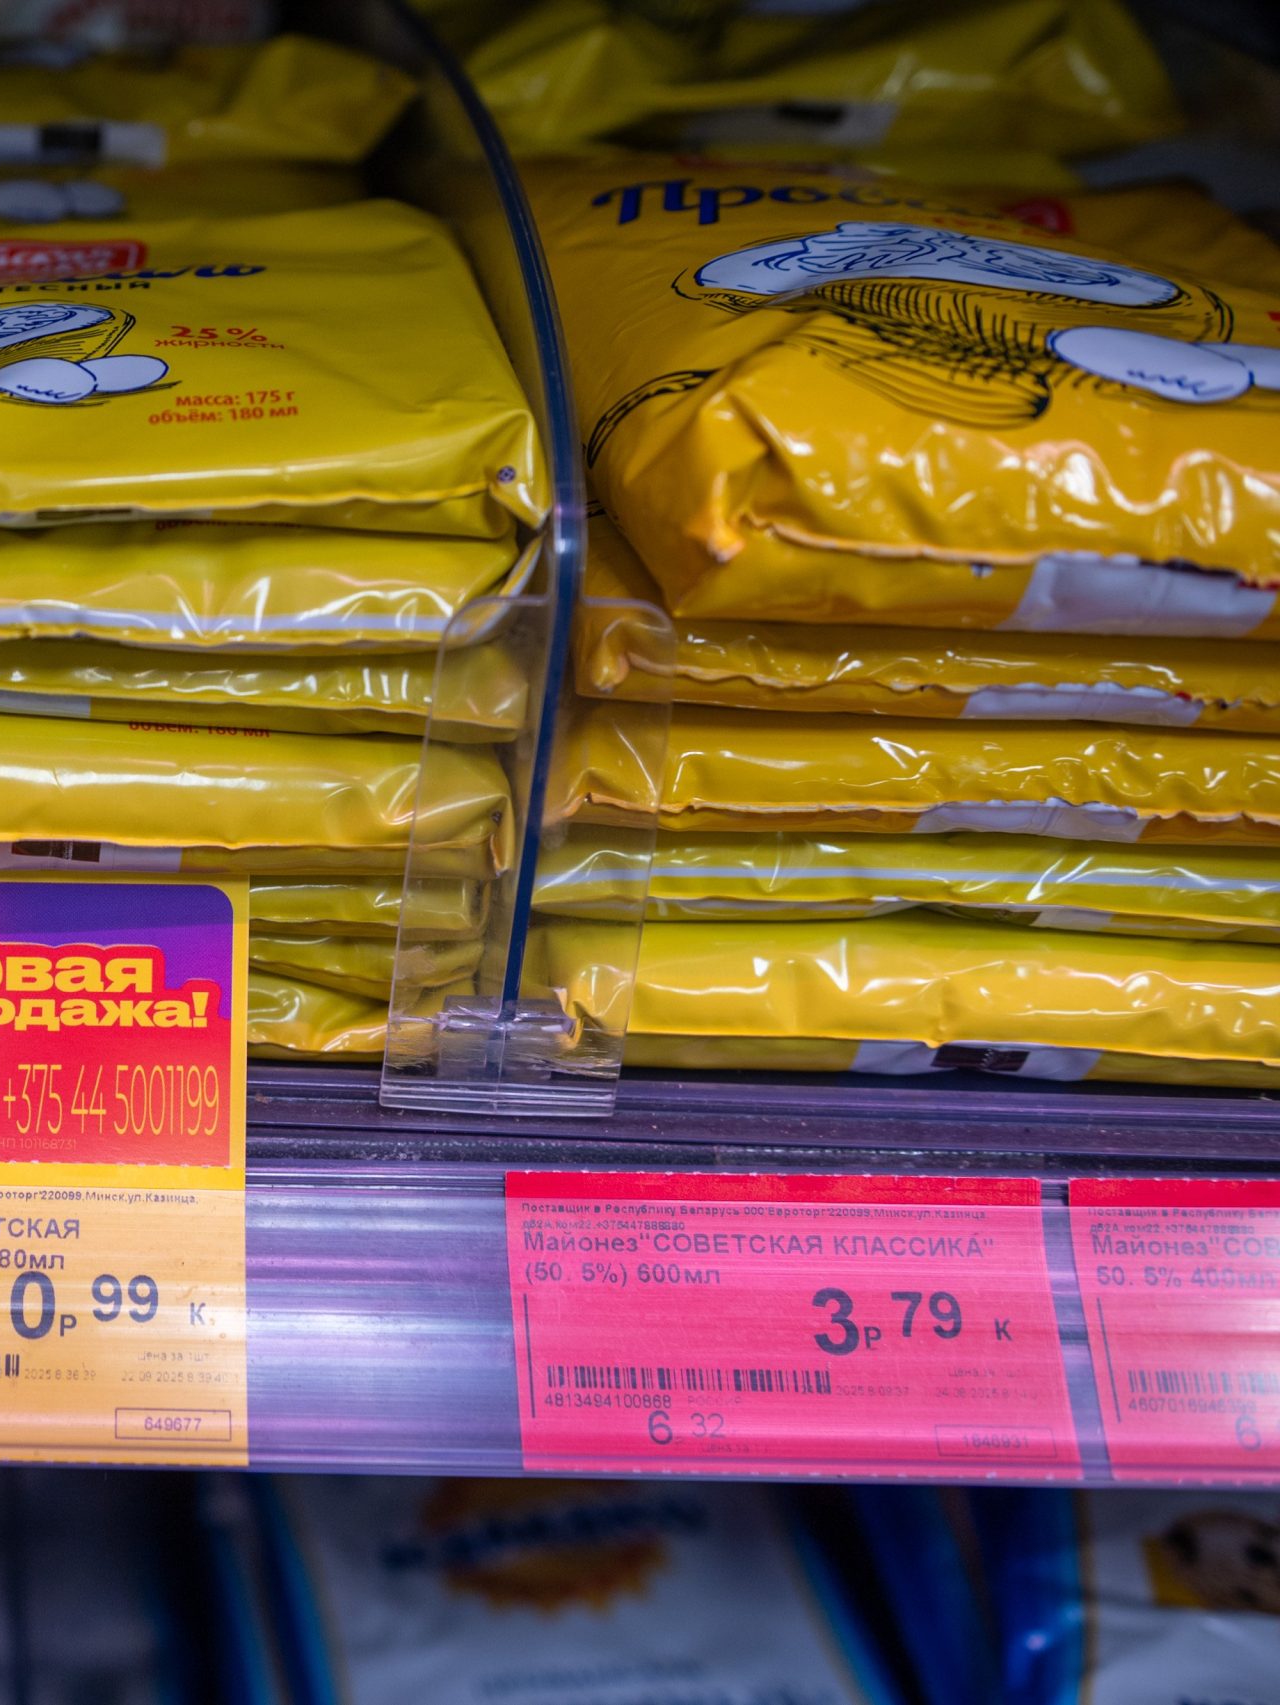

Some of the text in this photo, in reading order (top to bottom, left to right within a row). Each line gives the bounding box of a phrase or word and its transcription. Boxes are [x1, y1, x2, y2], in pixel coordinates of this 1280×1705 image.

[154, 339, 286, 349] жирности
[175, 391, 296, 407] масса: 175 г
[148, 407, 298, 425] объём: 180 мл
[3, 1063, 63, 1135] +375
[70, 1064, 107, 1135] 44
[113, 1064, 220, 1136] 5001199
[521, 1203, 590, 1214] Поставщик
[605, 1204, 675, 1218] Республику
[680, 1205, 740, 1217] Беларусь
[833, 1235, 994, 1258] КЛАССИКА"
[637, 1263, 721, 1284] 600мл
[1144, 1265, 1182, 1287] 5%
[10, 1270, 56, 1340] 0
[91, 1274, 159, 1323] 99
[812, 1287, 860, 1356] 3
[891, 1291, 963, 1340] 79
[544, 1393, 672, 1409] 4813494100868
[143, 1416, 202, 1432] 649677
[647, 1409, 726, 1445] 6 32
[1235, 1413, 1262, 1452] 6
